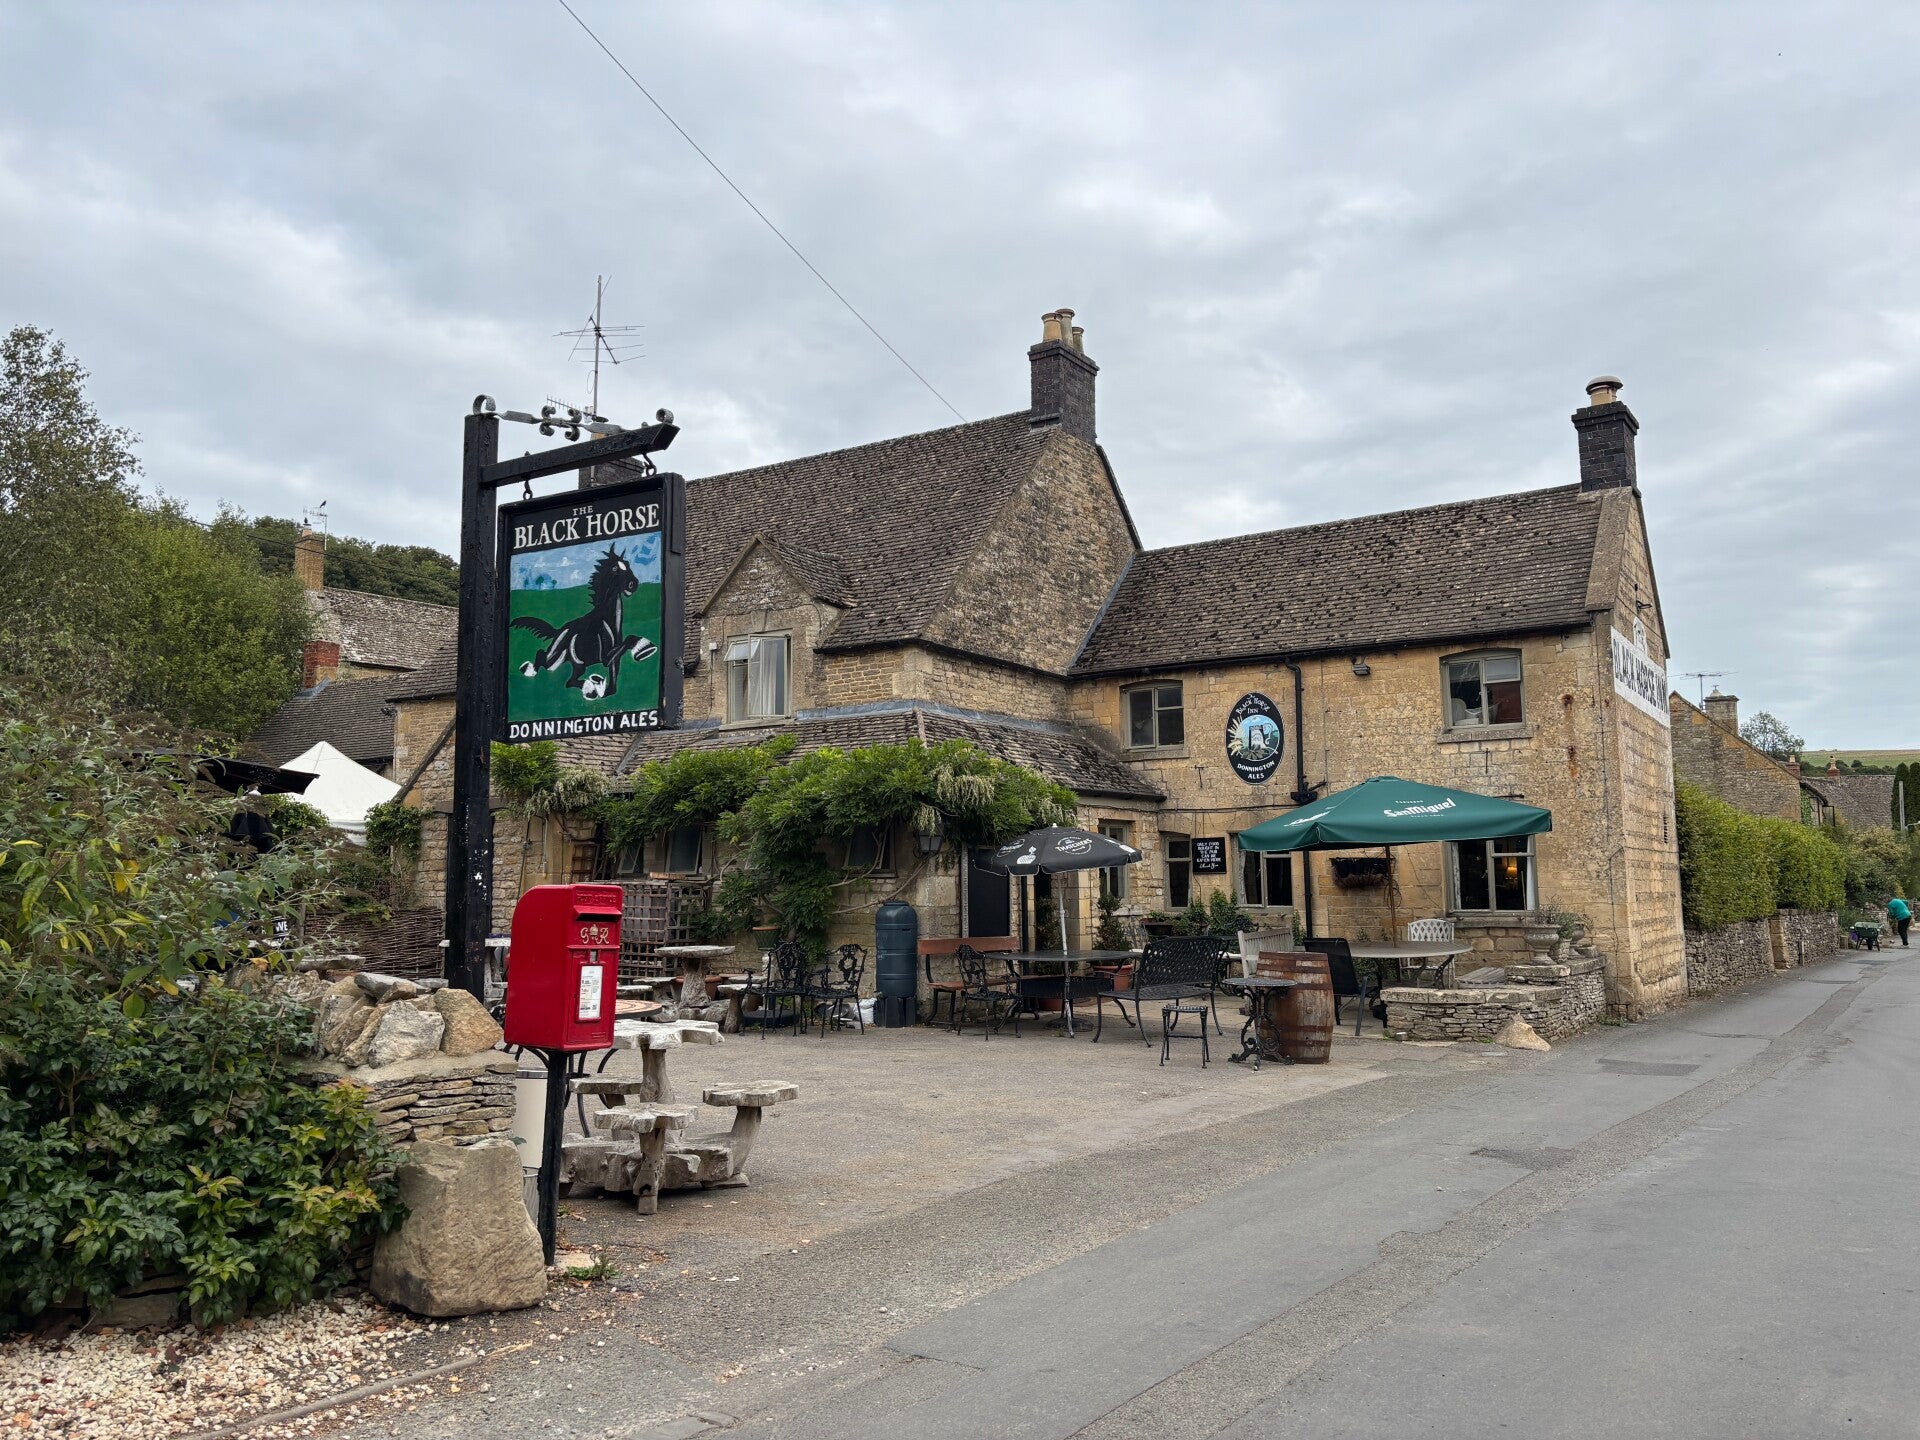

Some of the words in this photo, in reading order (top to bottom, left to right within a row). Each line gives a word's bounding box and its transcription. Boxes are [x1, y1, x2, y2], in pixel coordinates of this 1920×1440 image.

[572, 505, 594, 516] THE
[513, 517, 581, 549] BLACK
[585, 503, 660, 538] HORSE
[509, 715, 614, 739] DONNINGTON
[619, 710, 659, 729] ALES
[1237, 760, 1275, 772] DONNINGTON
[1247, 772, 1265, 780] ALES
